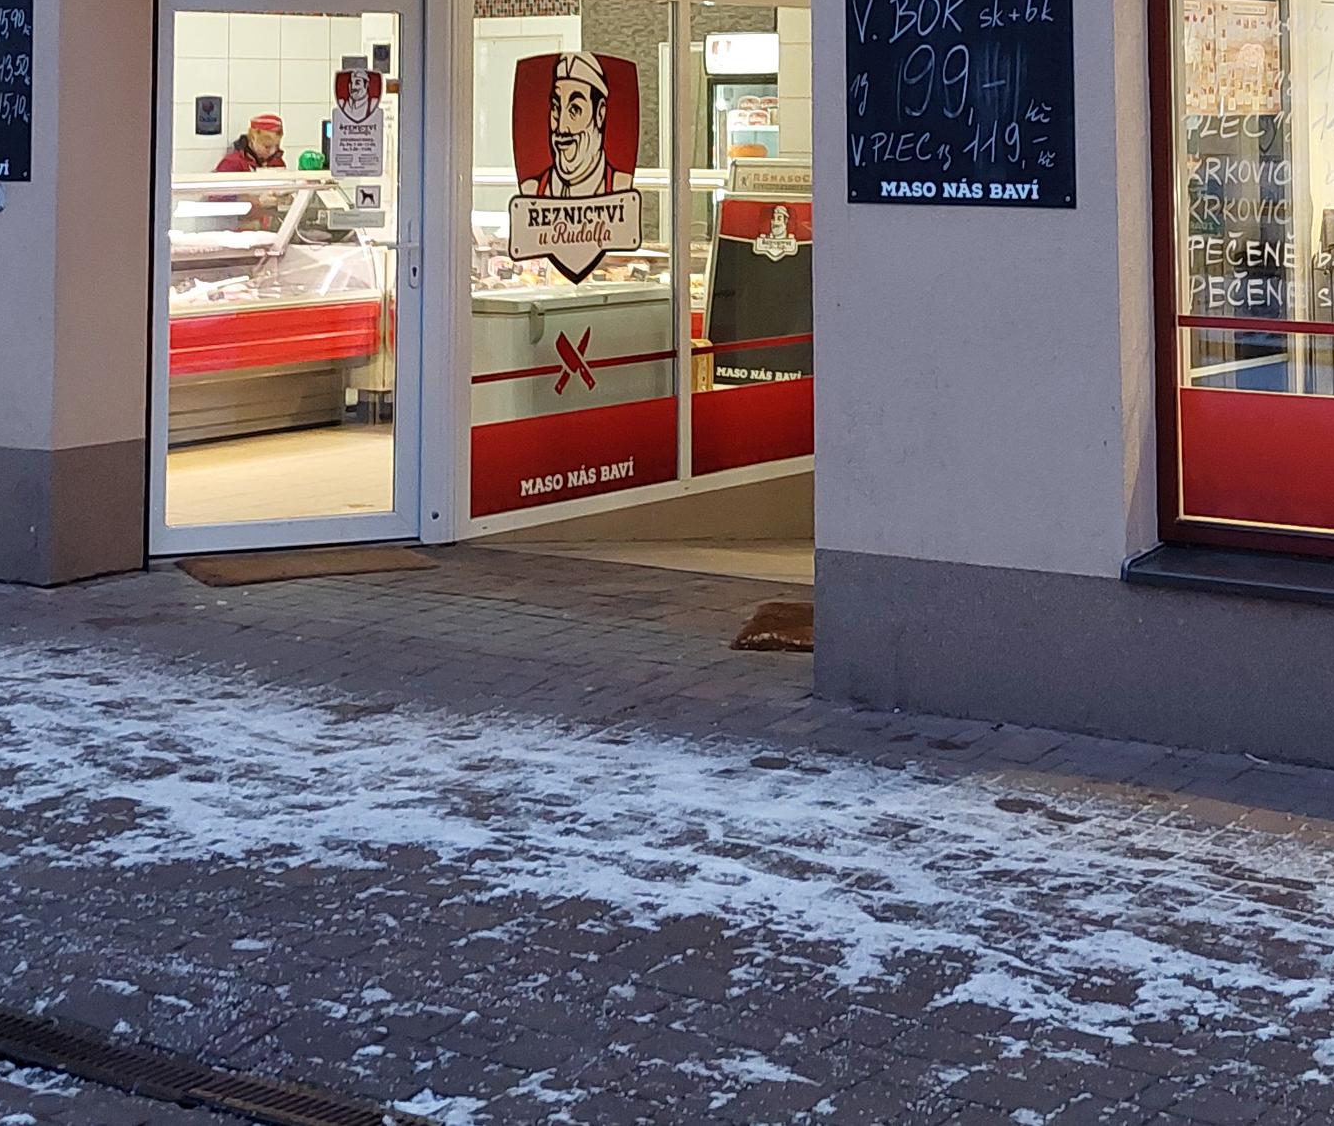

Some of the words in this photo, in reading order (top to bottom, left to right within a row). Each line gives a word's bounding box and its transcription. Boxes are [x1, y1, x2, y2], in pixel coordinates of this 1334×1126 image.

[870, 131, 933, 163] PLEC
[880, 180, 937, 198] MASO
[942, 178, 983, 199] NÁS
[989, 178, 1040, 200] BAVÍ
[527, 198, 624, 227] ŘEZNICTVÍ
[539, 232, 549, 245] u
[551, 220, 611, 248] Rudolfa
[716, 366, 748, 378] MASO
[750, 367, 772, 380] NÁS
[775, 370, 802, 382] BAVÍ
[520, 474, 563, 496] MASO
[567, 464, 596, 488] NÁS
[600, 456, 634, 482] BAVÍ
